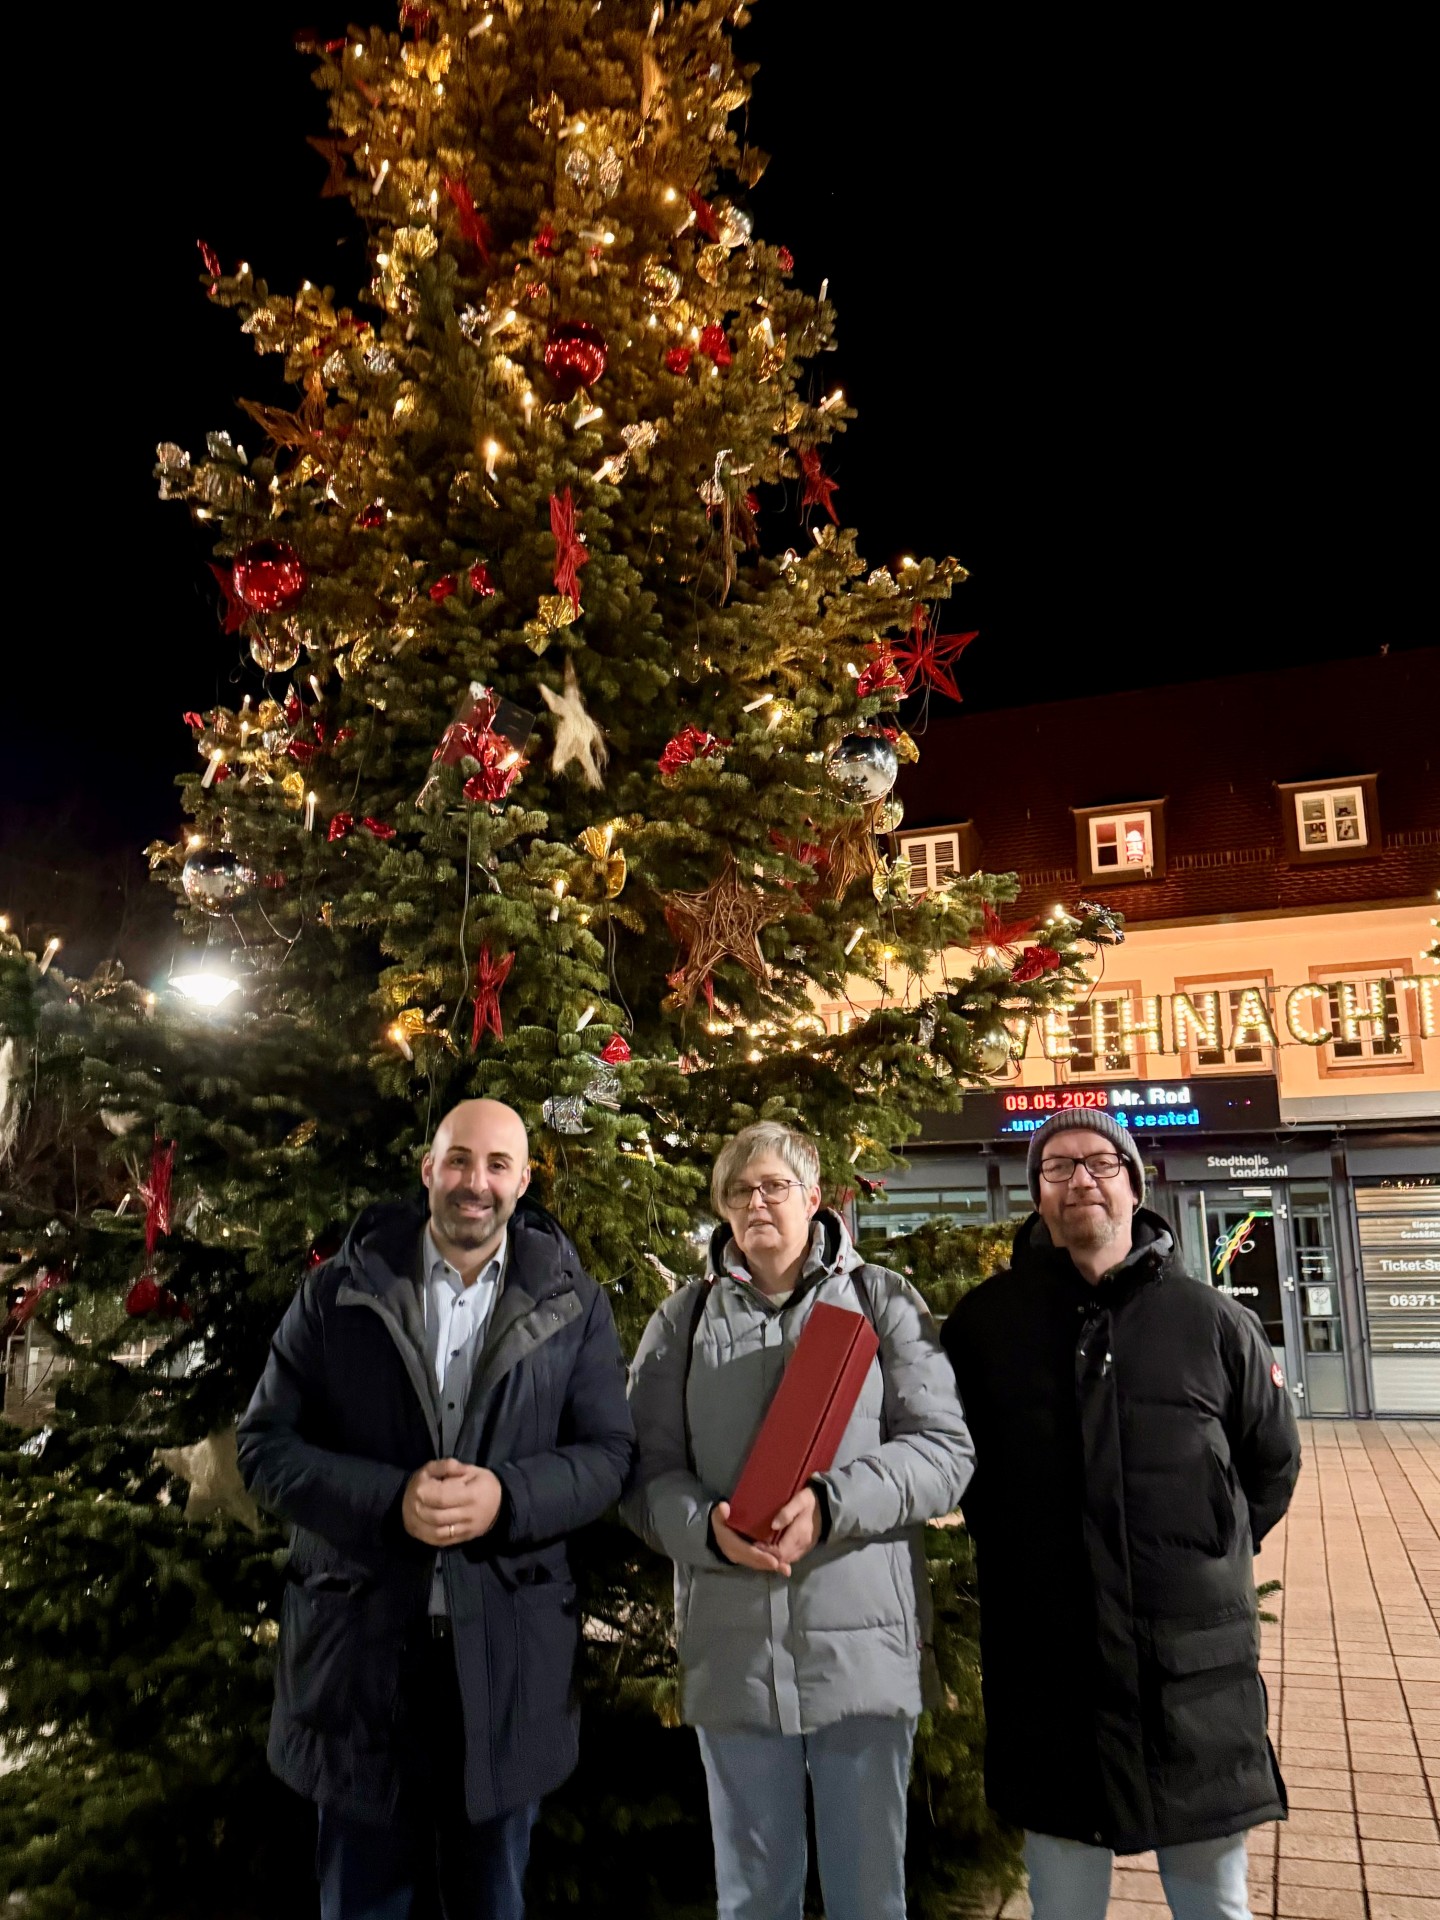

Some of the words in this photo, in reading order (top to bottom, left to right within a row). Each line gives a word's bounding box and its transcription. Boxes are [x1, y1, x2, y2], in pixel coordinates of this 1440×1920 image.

[1005, 1090, 1108, 1111] 09.05.2026
[1111, 1088, 1145, 1107] Mr.
[1148, 1086, 1191, 1105] Rod
[1115, 1111, 1129, 1128] &
[1134, 1109, 1200, 1127] seated
[1207, 1153, 1269, 1167] Stadthalle
[1230, 1164, 1289, 1177] Landstuhl
[1217, 1284, 1259, 1297] Eingang
